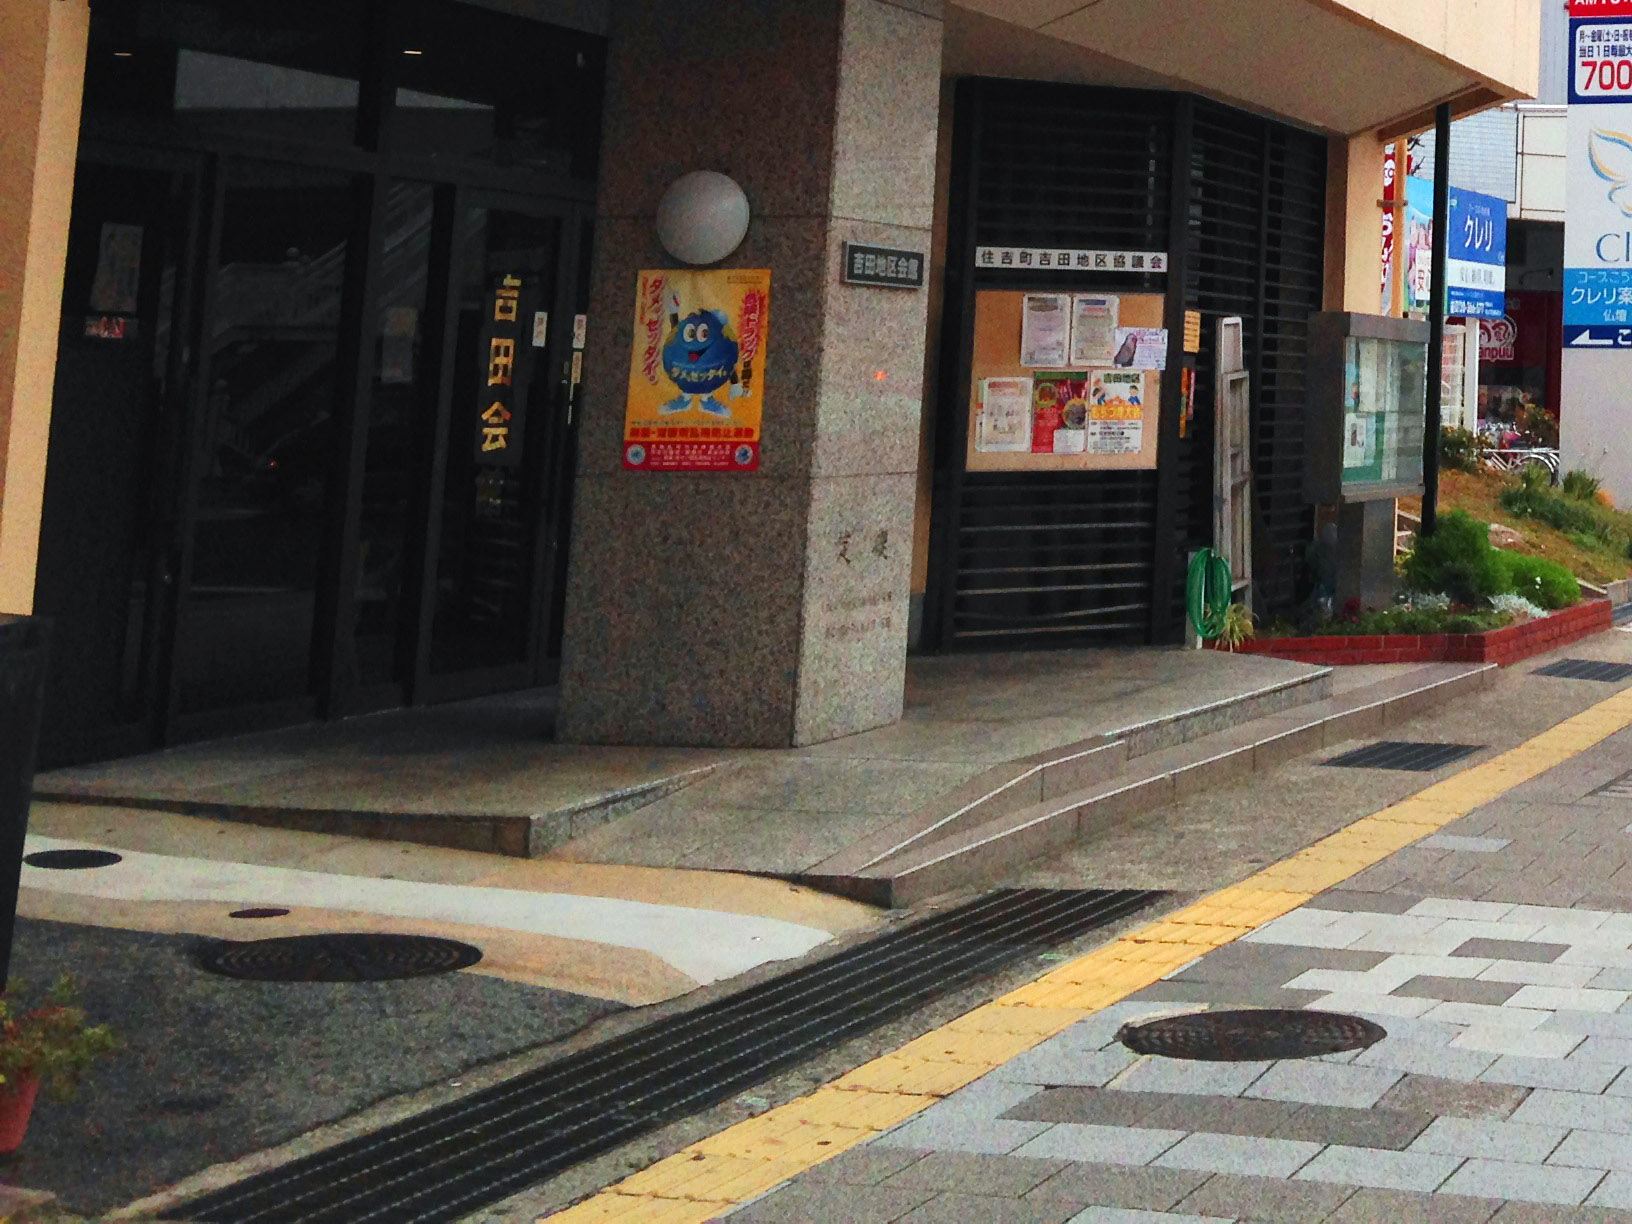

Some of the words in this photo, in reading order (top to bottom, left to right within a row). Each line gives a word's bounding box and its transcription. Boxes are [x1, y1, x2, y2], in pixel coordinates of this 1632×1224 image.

[1465, 214, 1493, 252] クレリ
[853, 251, 919, 280] 吉田地区会館
